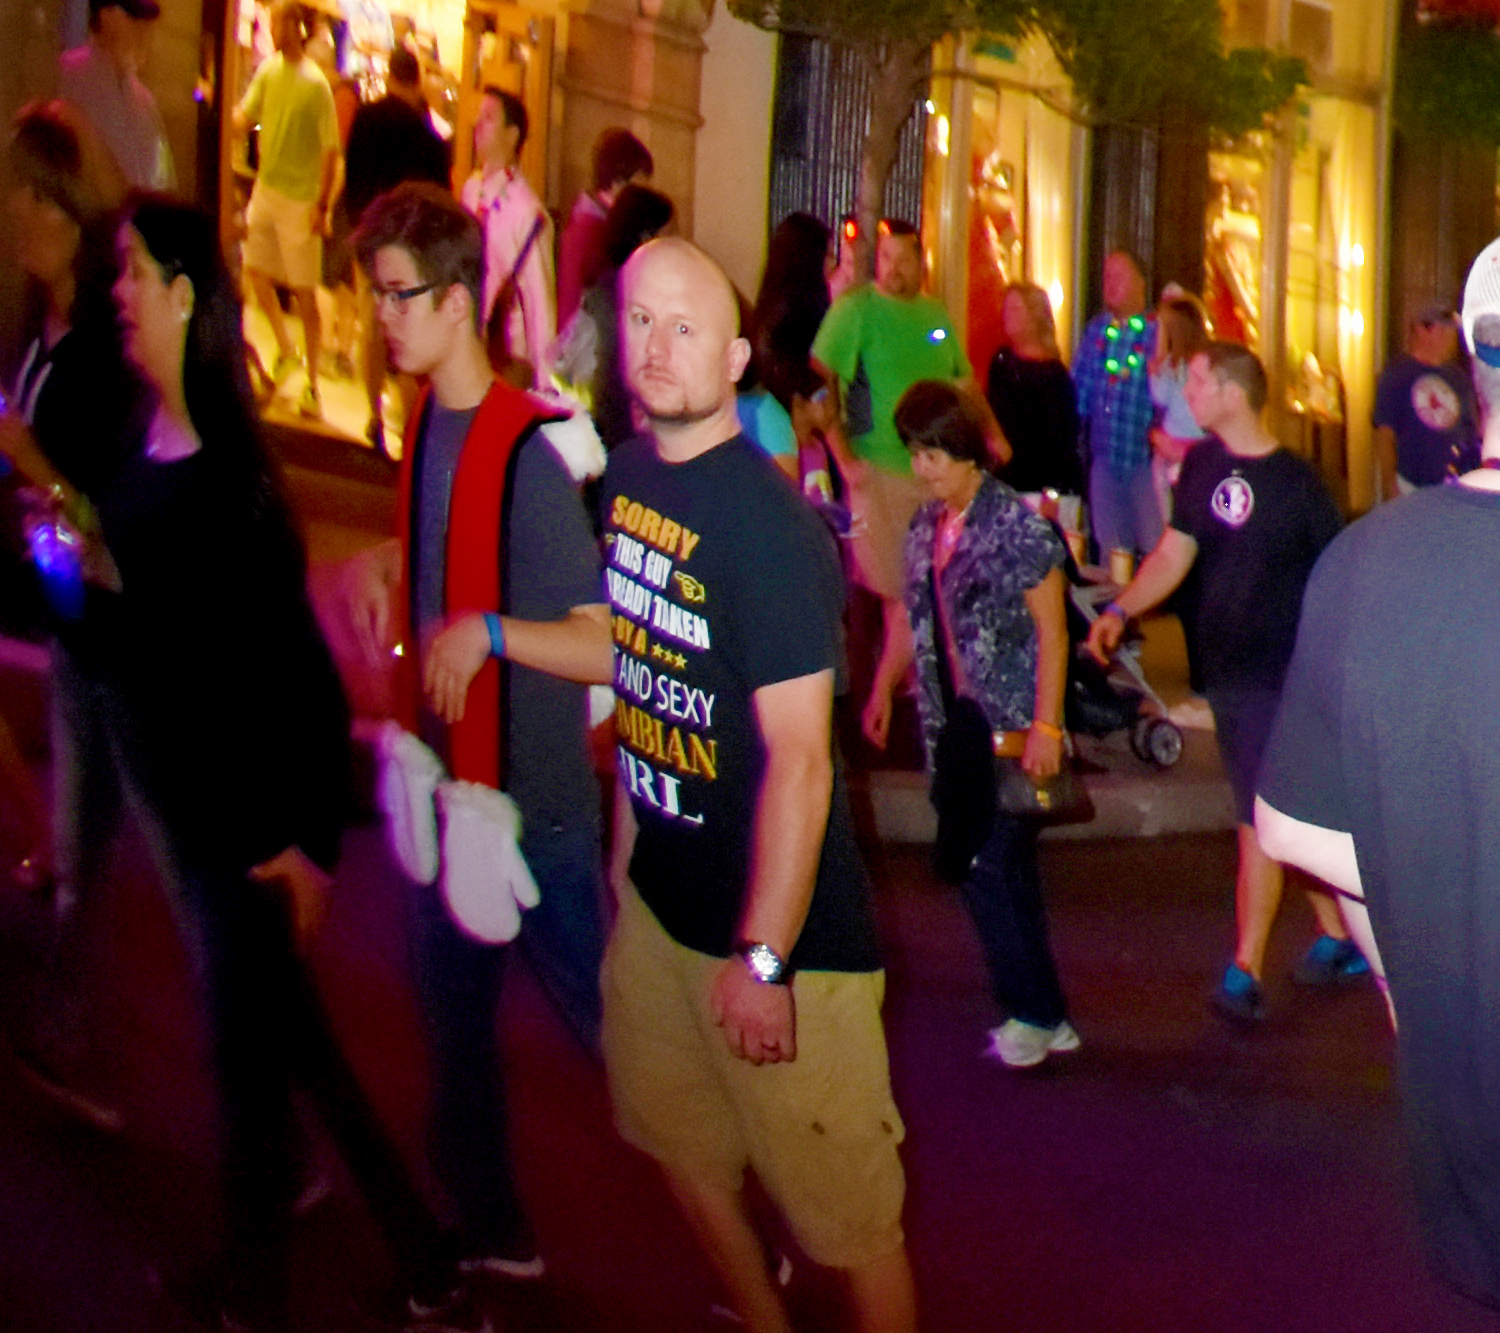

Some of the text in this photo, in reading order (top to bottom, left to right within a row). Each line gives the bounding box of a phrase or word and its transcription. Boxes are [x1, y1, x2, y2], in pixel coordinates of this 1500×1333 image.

[611, 494, 700, 561] SORRY
[615, 532, 673, 589] THIS GUY
[632, 627, 648, 655] A
[653, 595, 710, 649] TAKEN
[618, 653, 715, 727] AND SEXY
